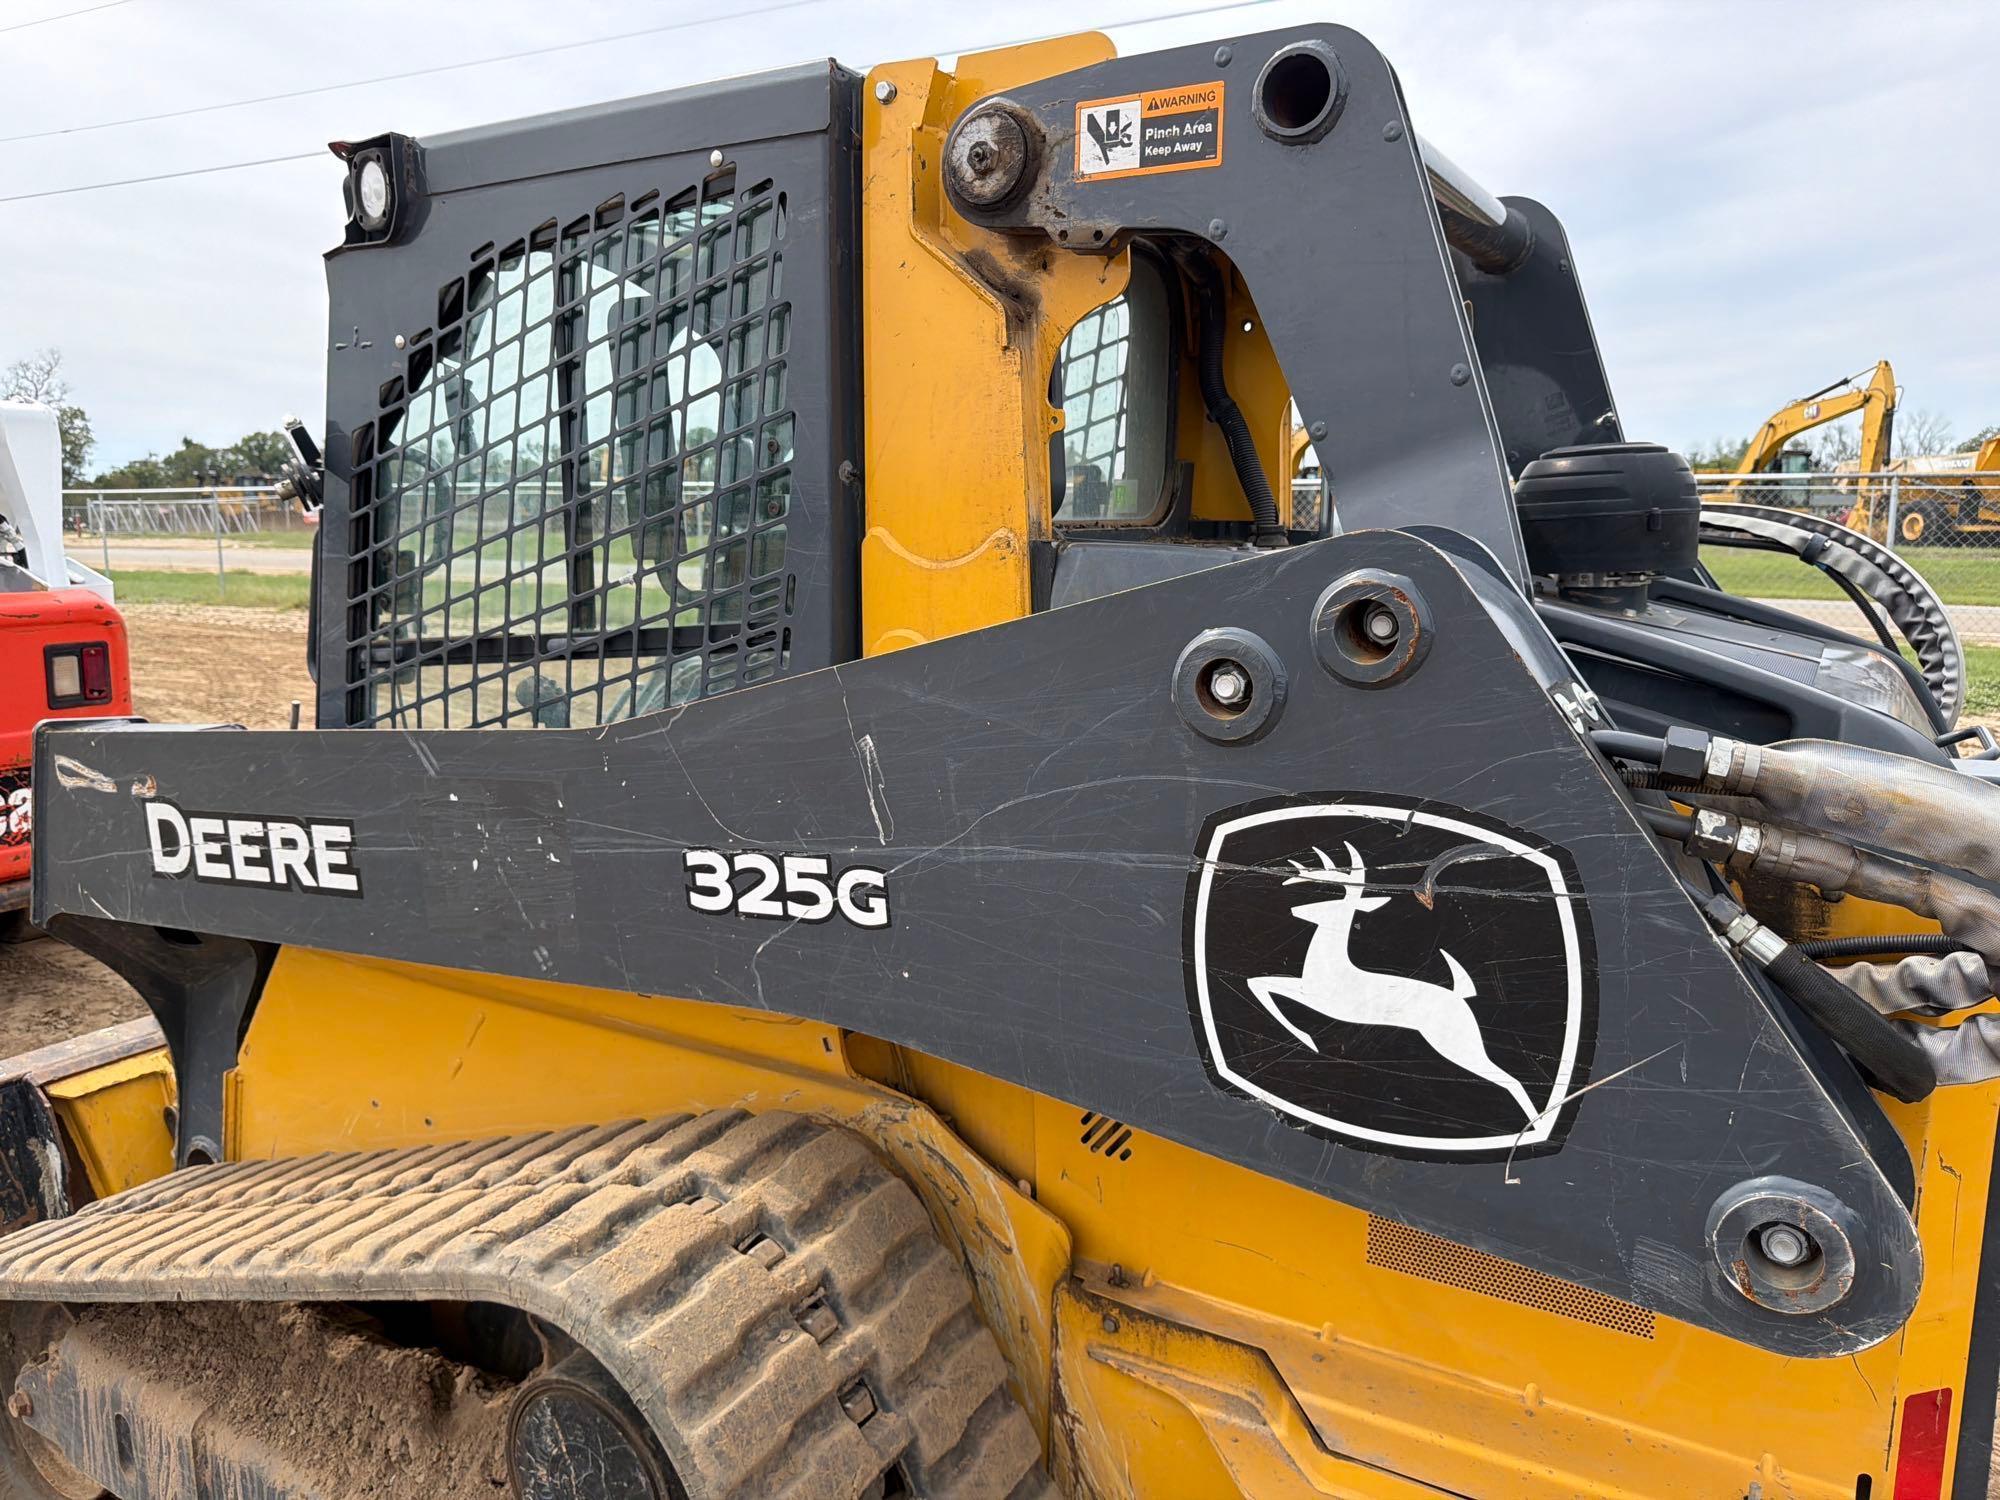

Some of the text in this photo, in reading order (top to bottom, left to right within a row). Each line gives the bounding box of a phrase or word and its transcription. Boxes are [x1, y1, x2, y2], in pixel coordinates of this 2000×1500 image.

[1159, 90, 1216, 109] WARNING
[1145, 122, 1213, 141] Pinch Area
[1145, 140, 1203, 157] Keep Away
[145, 802, 359, 891] DEERE
[685, 850, 888, 926] 325G
